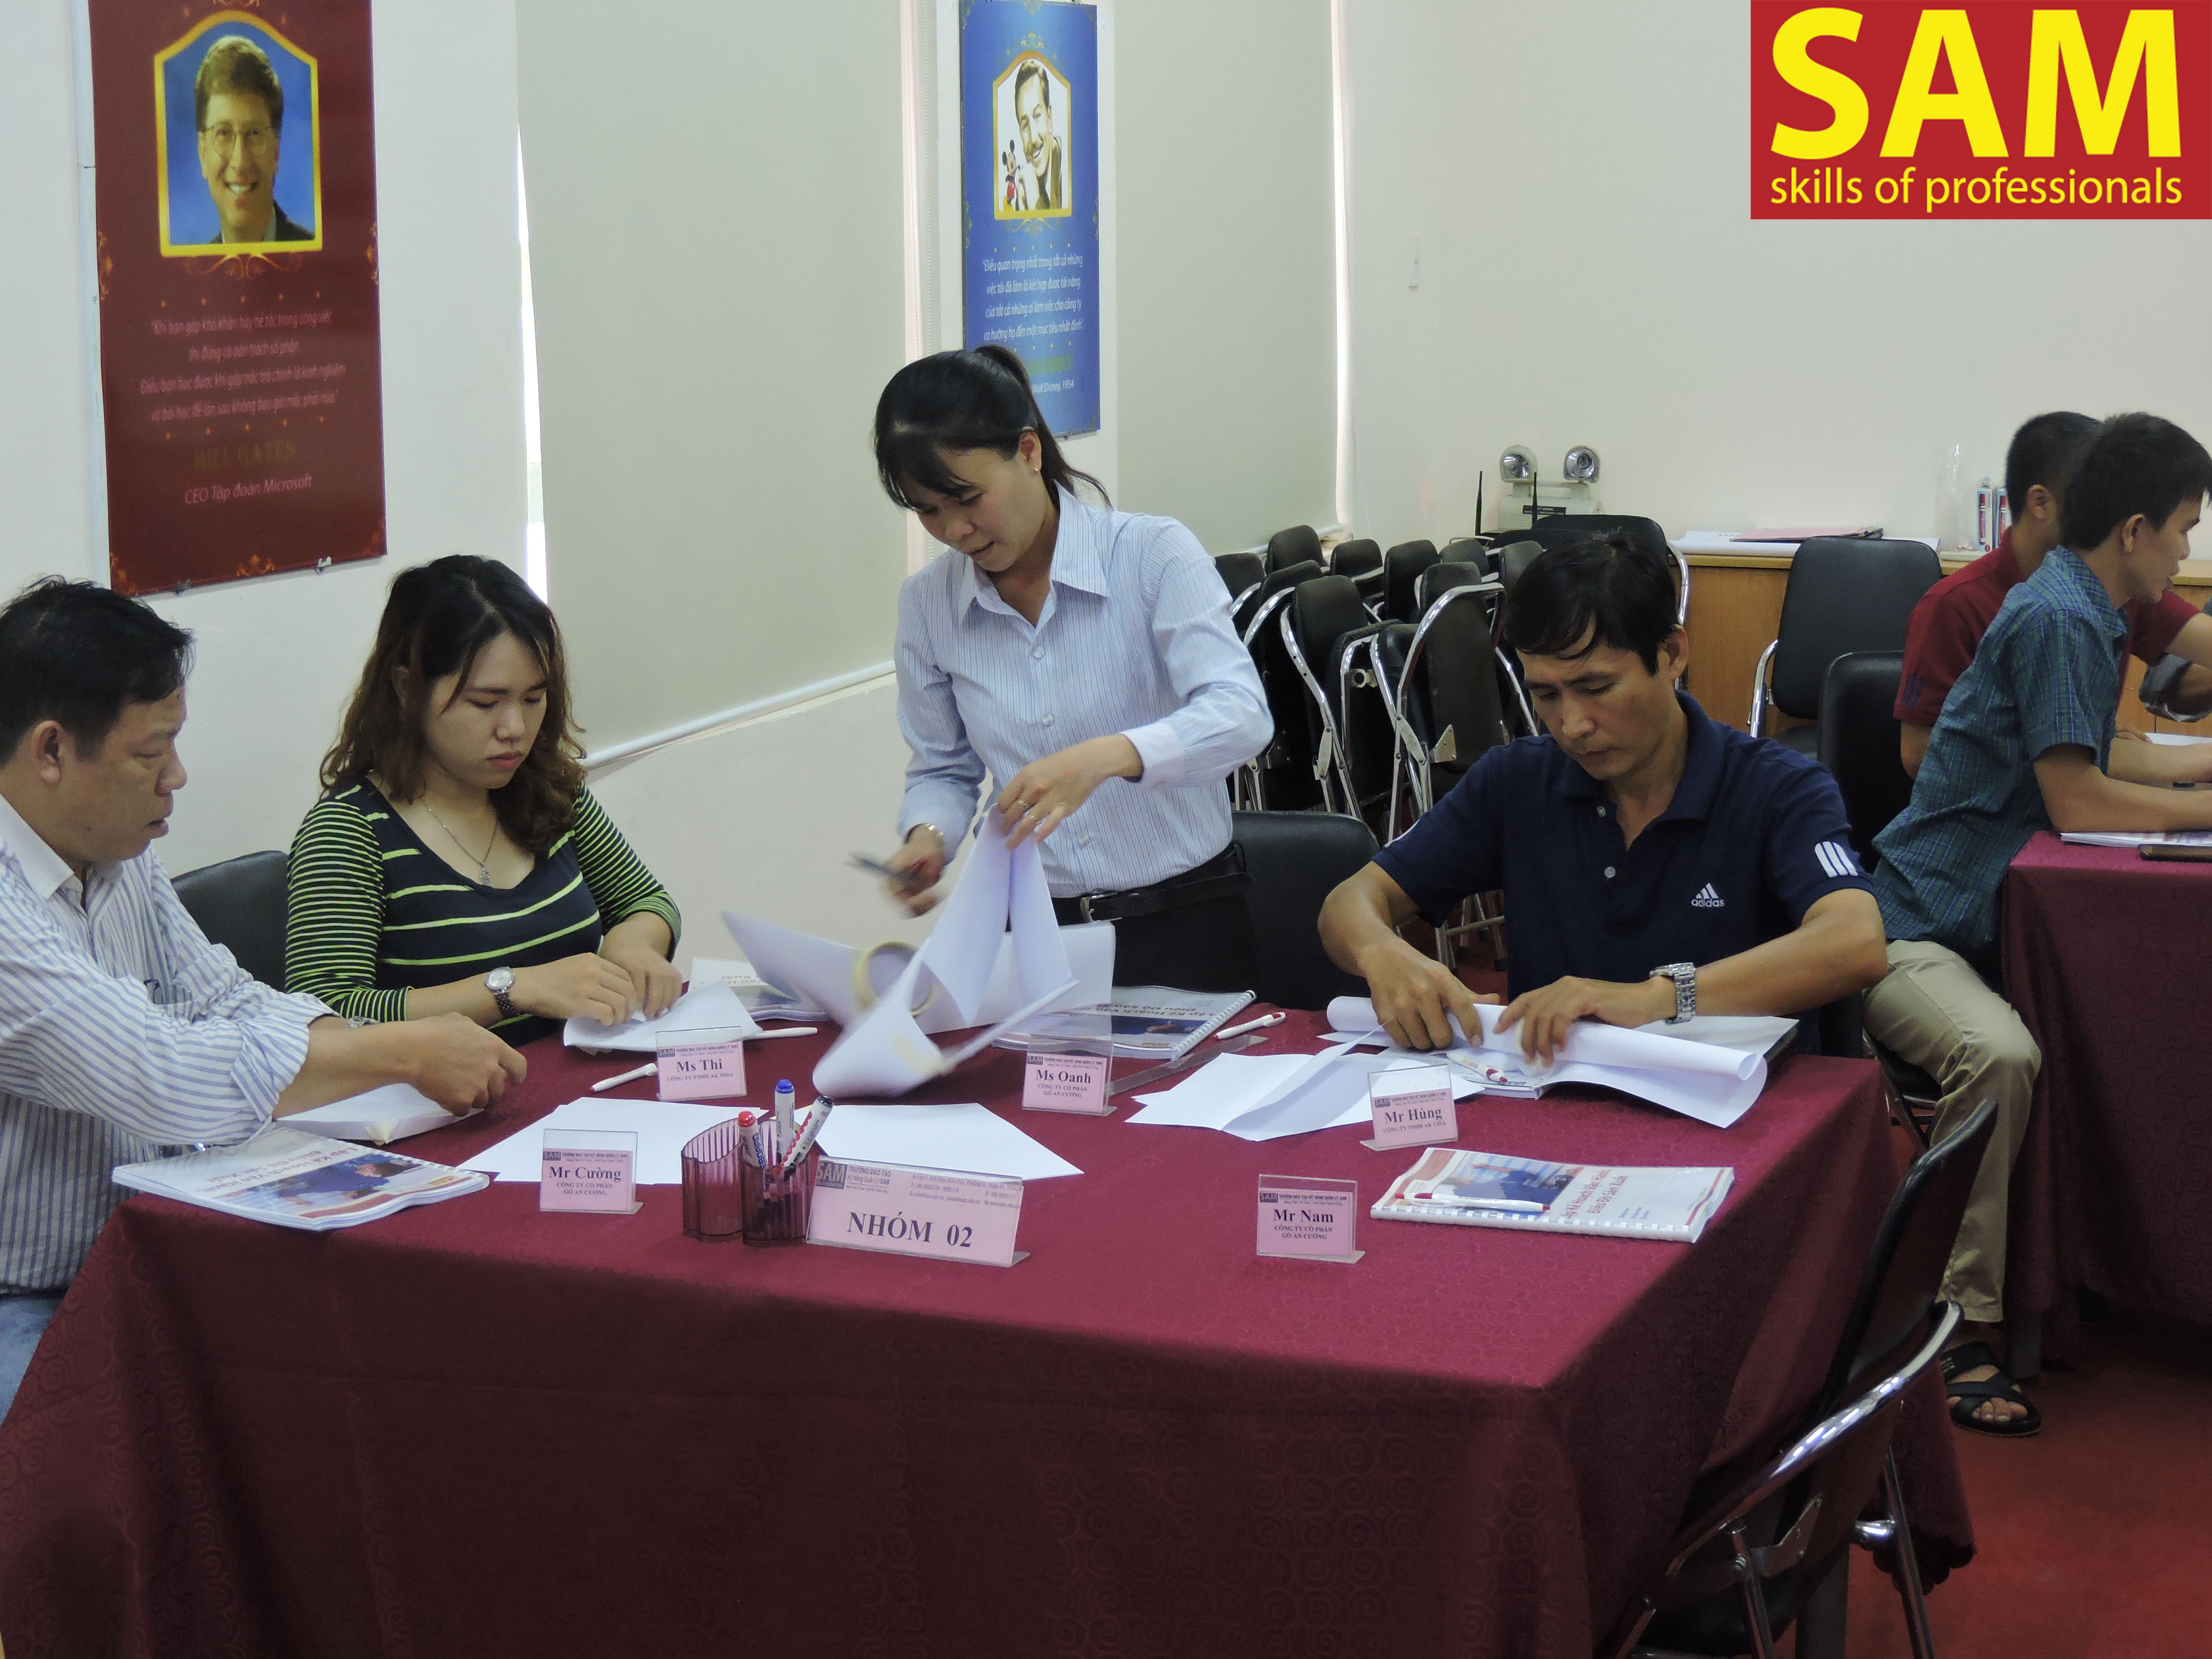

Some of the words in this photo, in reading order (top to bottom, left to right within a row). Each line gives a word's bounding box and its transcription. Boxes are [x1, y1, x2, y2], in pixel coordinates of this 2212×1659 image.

[998, 259, 1011, 274] quan
[1062, 379, 1075, 389] 1954
[185, 487, 208, 505] CEO
[263, 472, 312, 494] Microsoft
[1691, 898, 1725, 907] adidas
[676, 1061, 696, 1072] Ms
[699, 1058, 722, 1070] Thi
[1036, 1069, 1054, 1081] Ms
[1058, 1070, 1091, 1083] Oanh
[1385, 1111, 1404, 1124] Mr
[1408, 1108, 1443, 1120] Hùng
[549, 1166, 570, 1178] Mr
[575, 1167, 621, 1182] Cường
[816, 1162, 845, 1182] SAM
[1273, 1209, 1296, 1221] Mr
[1300, 1210, 1334, 1223] Nam
[847, 1211, 934, 1242] NHÓM
[947, 1225, 973, 1248] 02
